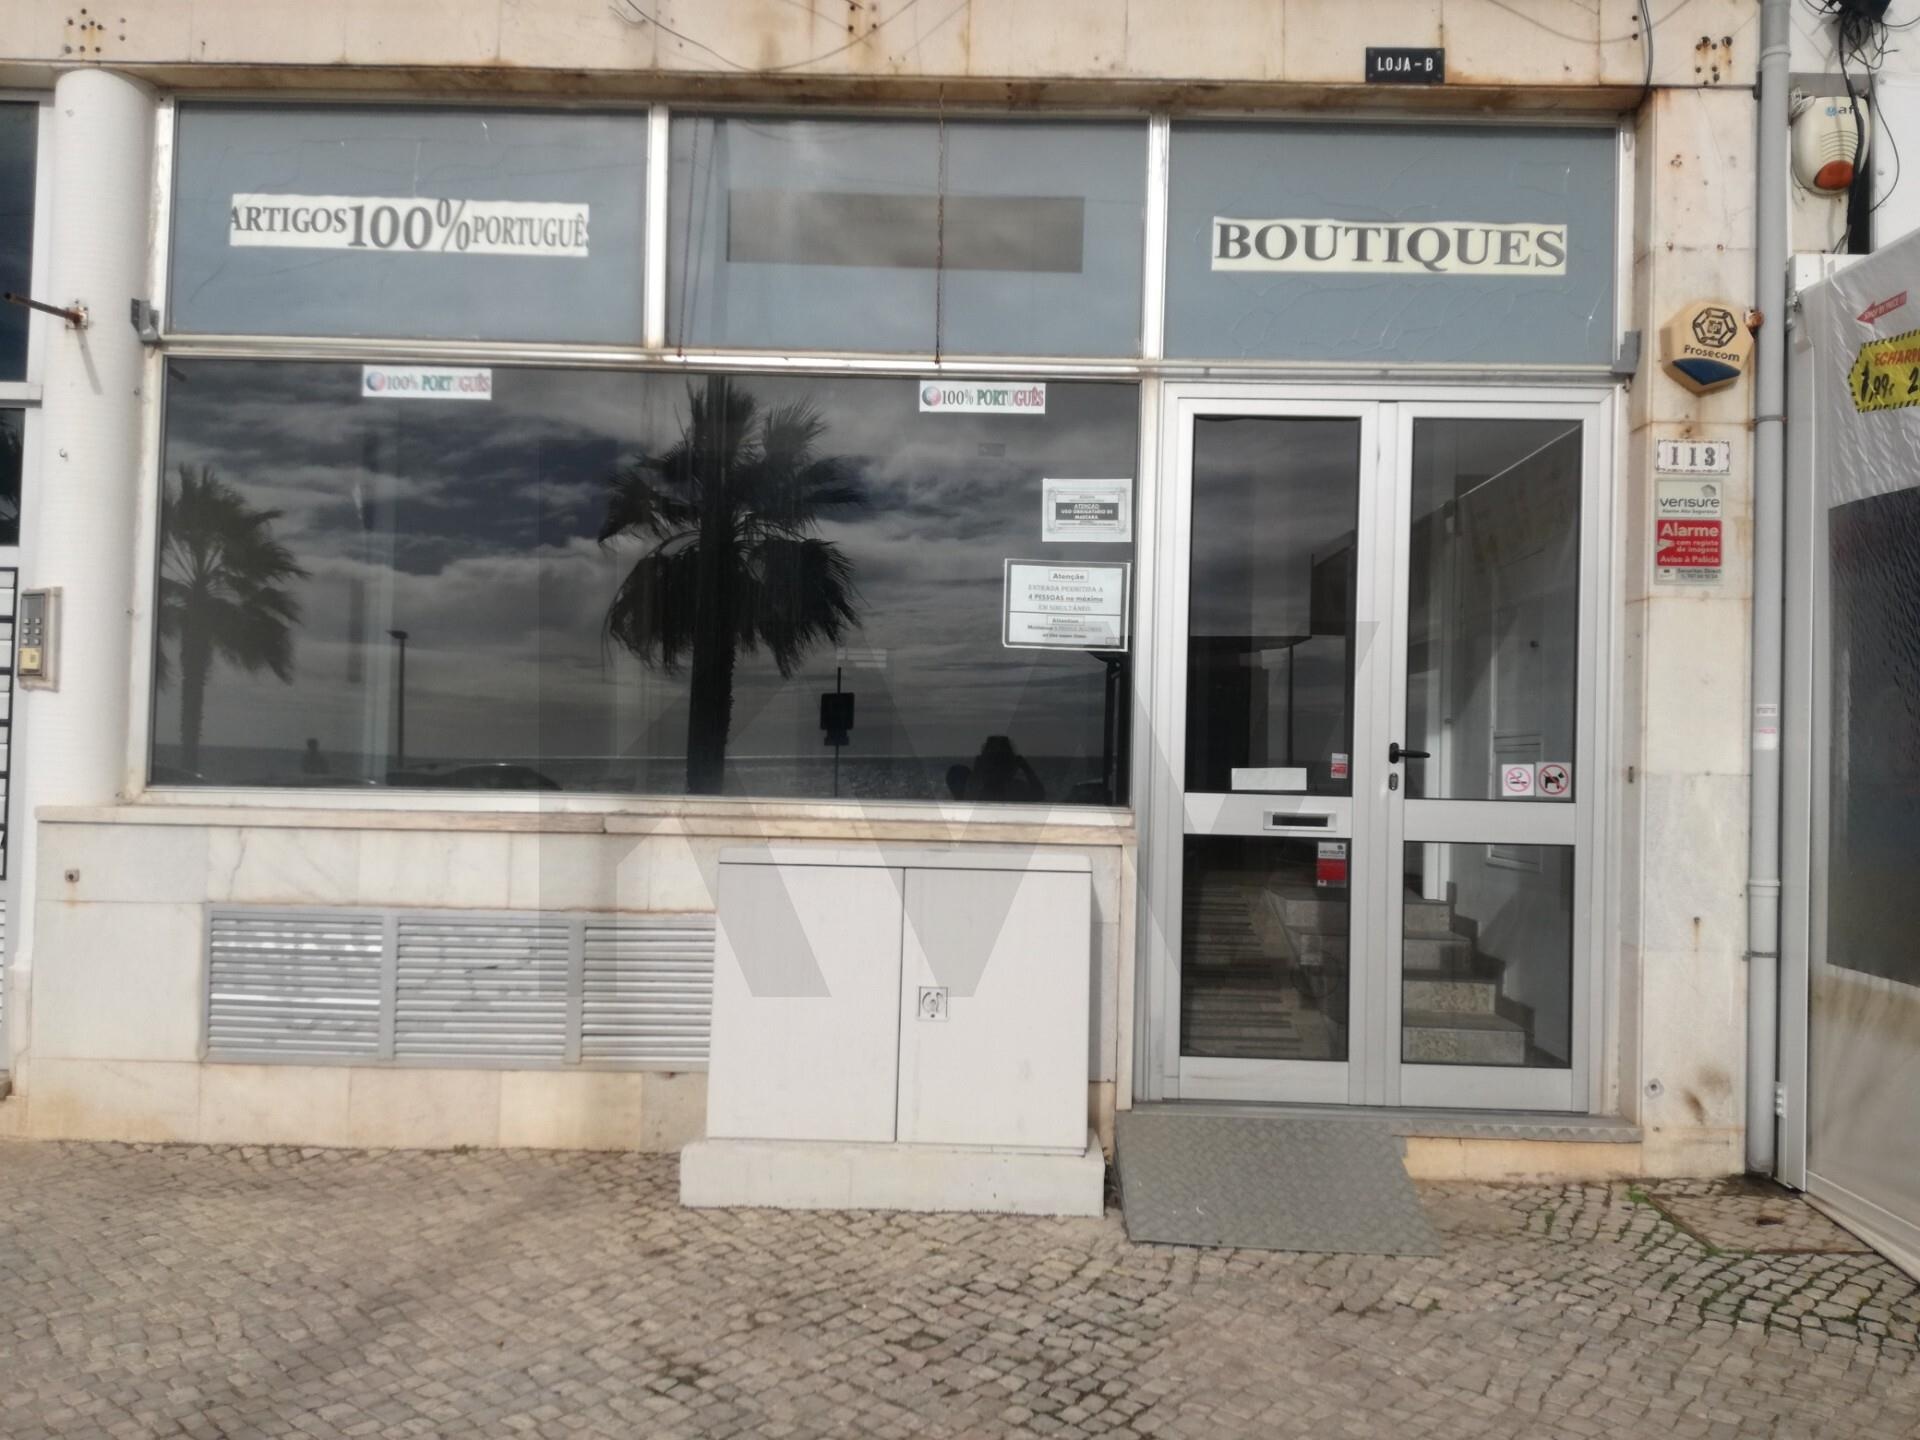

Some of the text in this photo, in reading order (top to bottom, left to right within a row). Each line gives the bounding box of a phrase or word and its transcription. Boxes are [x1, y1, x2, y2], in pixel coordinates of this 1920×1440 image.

[231, 206, 347, 234] ARTIGOS
[347, 199, 471, 251] 100%
[1214, 222, 1566, 273] BOUTIQUES
[1684, 344, 1741, 363] Prosecom
[386, 373, 418, 391] 100%
[942, 386, 1044, 407] 100% PORTUGUÊS
[1670, 446, 1717, 468] 113
[1660, 497, 1720, 508] verisure
[1661, 521, 1720, 538] Alarme
[1053, 572, 1085, 581] Atenção
